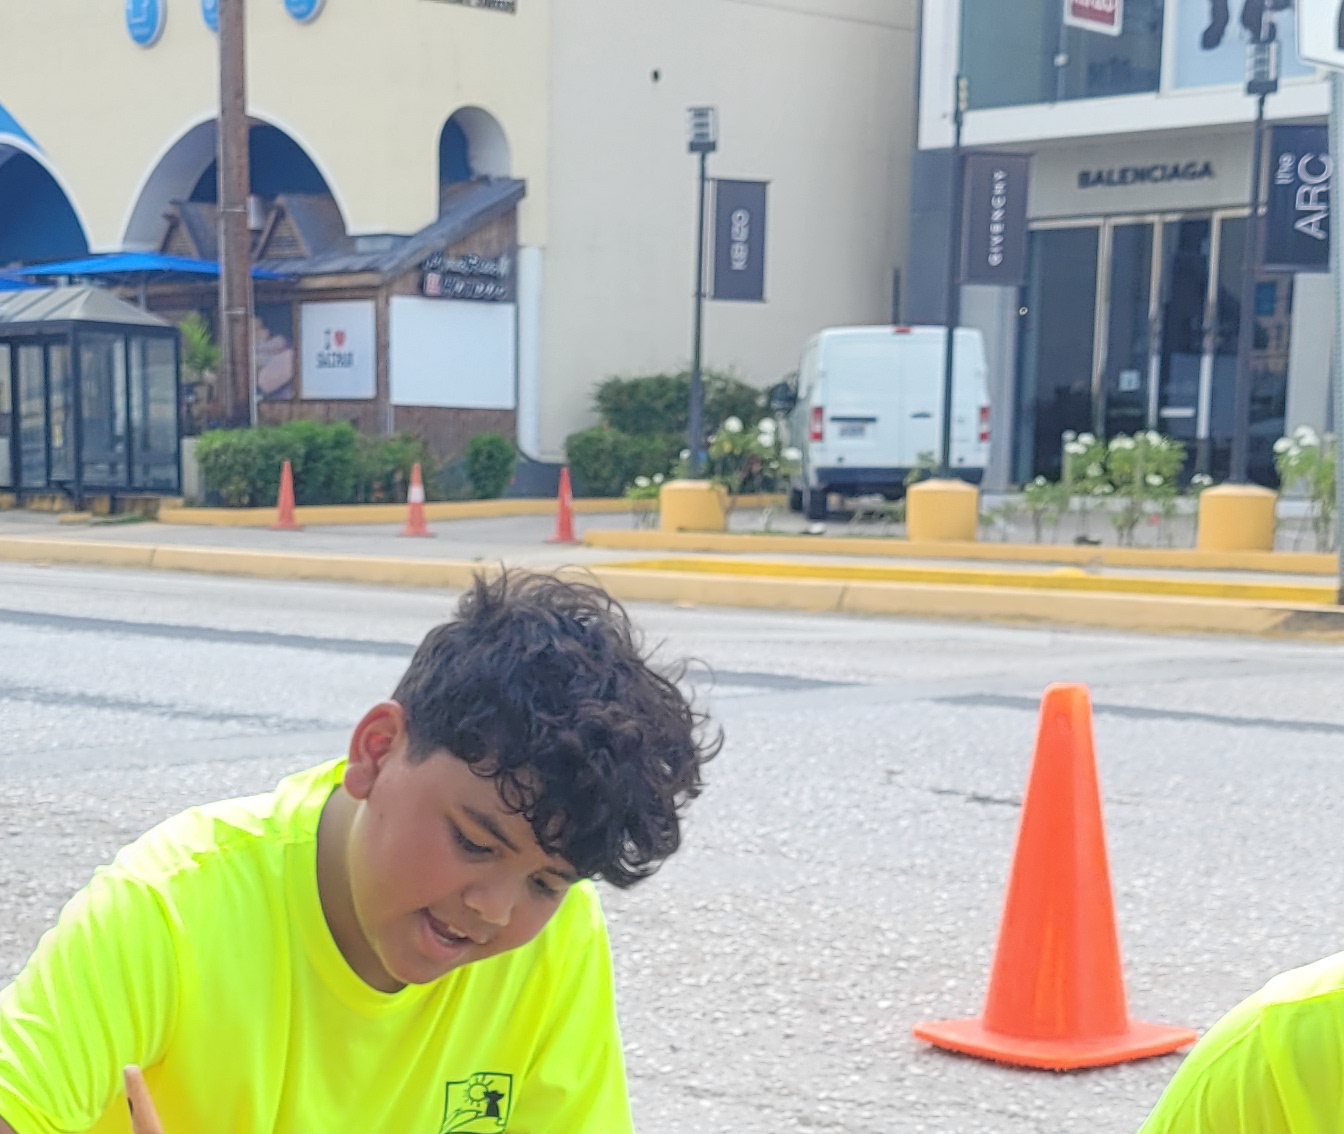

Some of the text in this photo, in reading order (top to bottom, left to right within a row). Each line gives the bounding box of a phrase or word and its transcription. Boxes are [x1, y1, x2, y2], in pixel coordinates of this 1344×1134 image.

[987, 169, 1007, 267] GIVENCHY
[1077, 160, 1216, 189] BALENCIAGA
[1294, 152, 1333, 240] ARC
